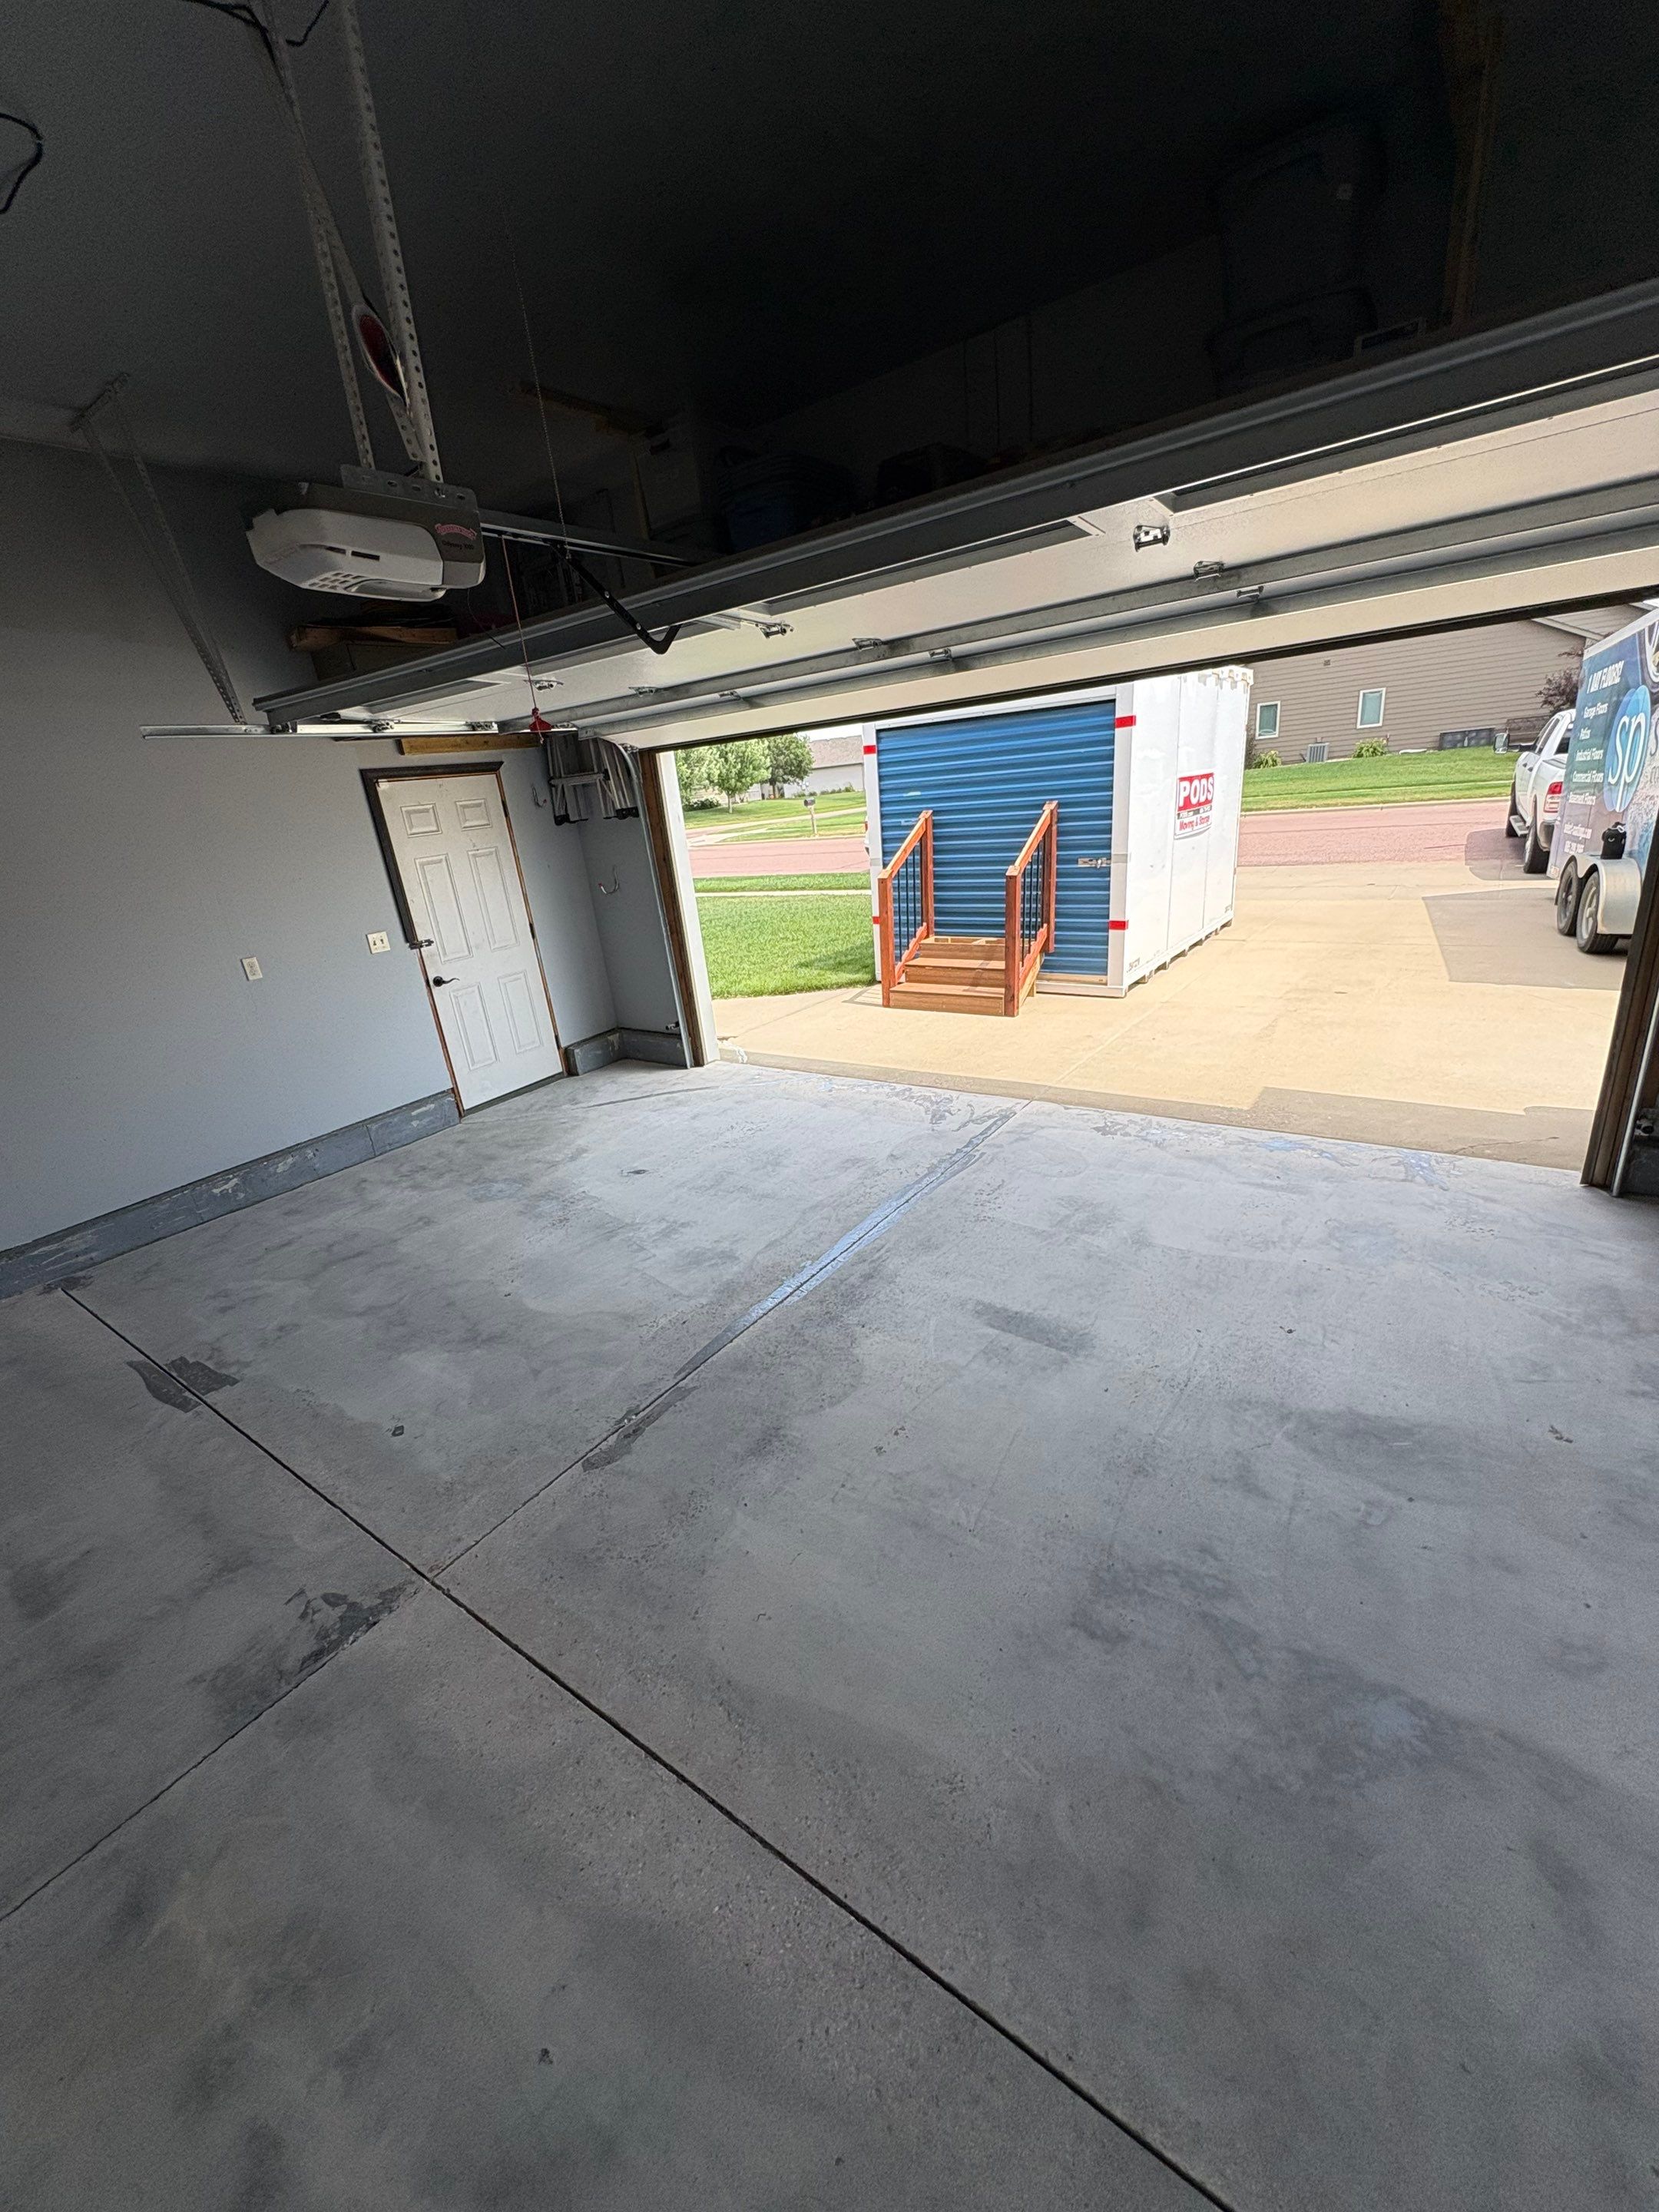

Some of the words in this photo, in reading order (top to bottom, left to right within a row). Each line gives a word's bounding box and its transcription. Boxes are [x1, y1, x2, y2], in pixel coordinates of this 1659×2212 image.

[1594, 702, 1609, 718] Floors
[1178, 776, 1214, 807] PODS
[1179, 819, 1195, 832] Moving
